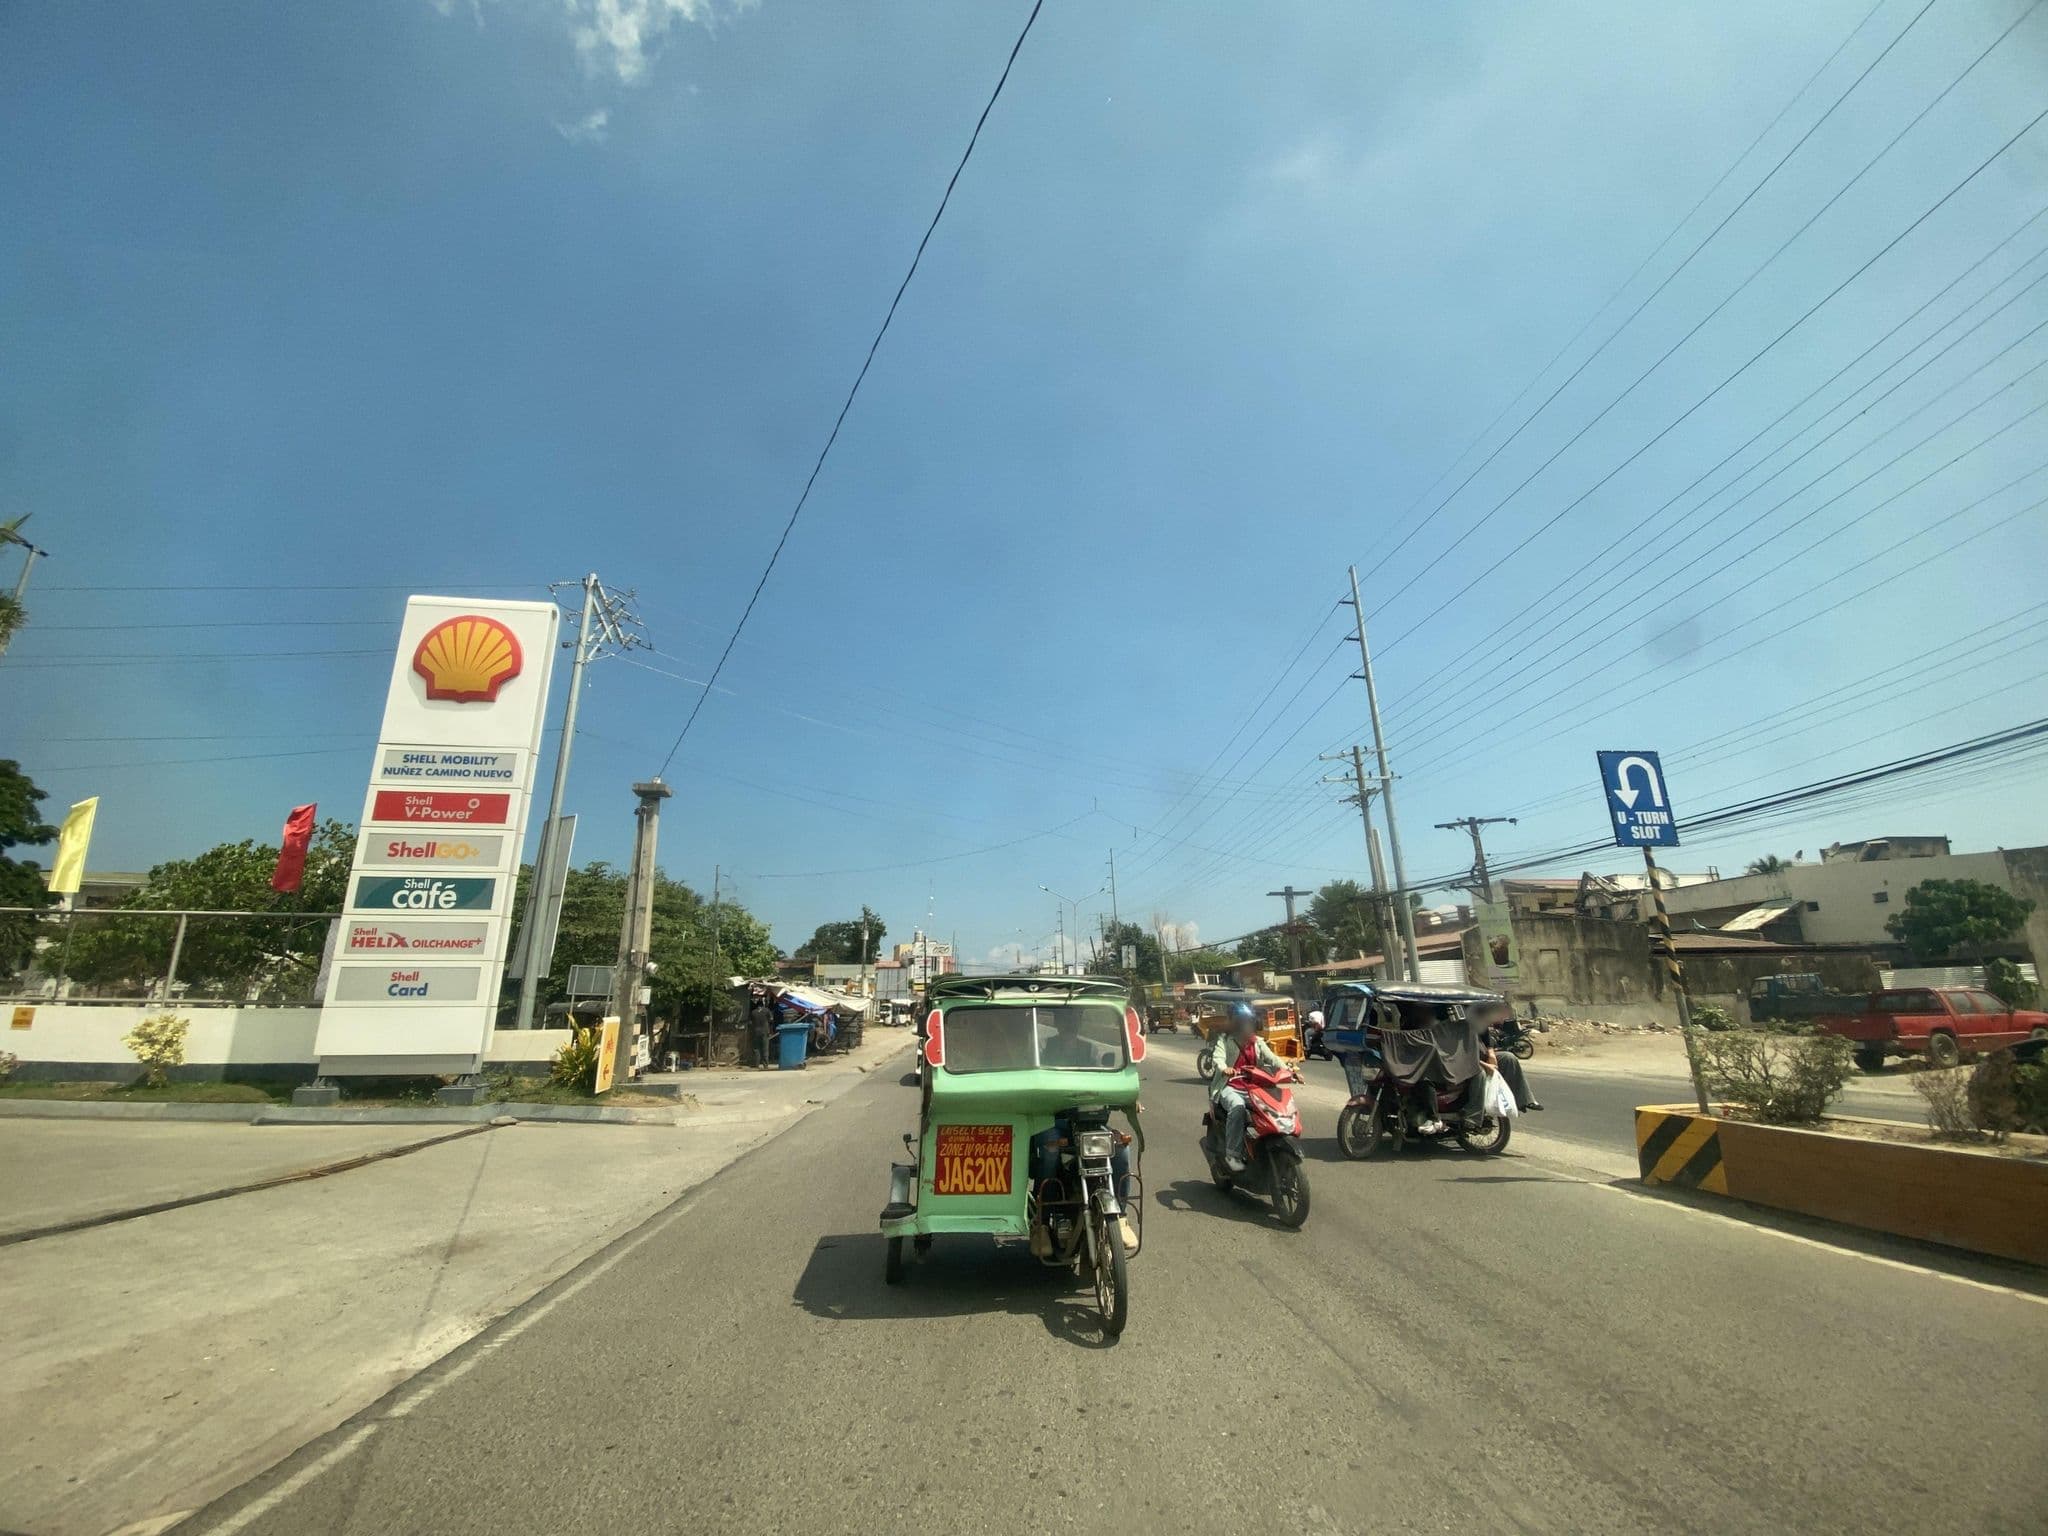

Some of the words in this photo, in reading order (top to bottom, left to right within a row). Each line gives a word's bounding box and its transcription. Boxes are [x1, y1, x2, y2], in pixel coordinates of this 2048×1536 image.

[402, 754, 437, 764] SHELL
[440, 755, 499, 766] MOBILITY
[383, 765, 423, 776] NUÑEZ
[425, 768, 472, 778] CAMINO
[473, 769, 513, 778] NUEVO
[405, 796, 433, 805] Shell
[405, 806, 473, 820] V-Power
[1630, 826, 1661, 839] SLOT
[404, 879, 430, 889] Shell
[392, 881, 458, 909] café
[353, 927, 378, 936] Shell
[351, 932, 409, 948] HELIX
[390, 971, 420, 982] Shell
[388, 982, 429, 996] Card
[940, 1143, 964, 1157] ZONE
[939, 1157, 1008, 1193] JA620X
